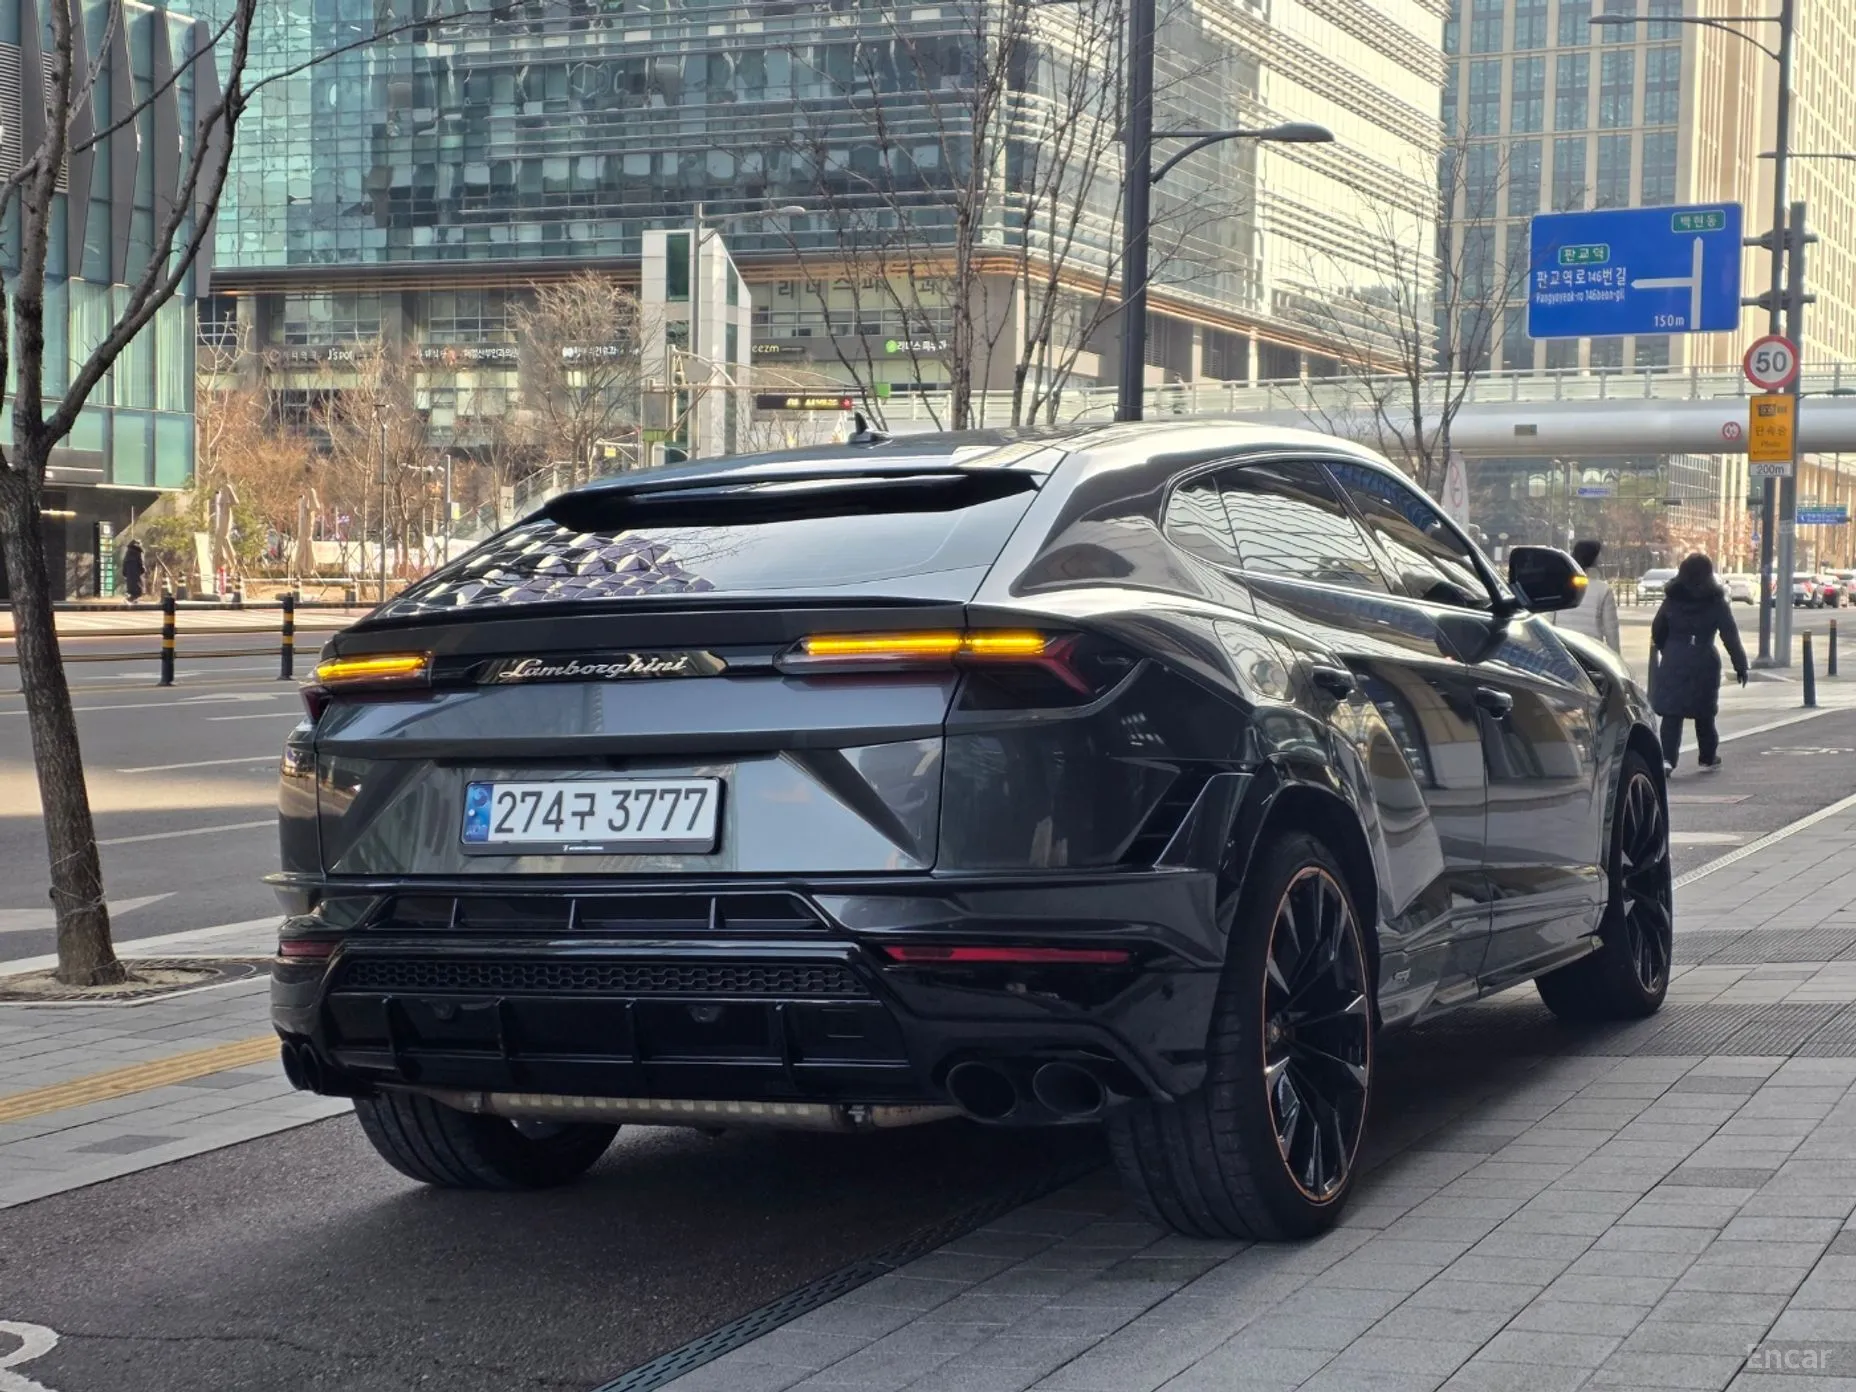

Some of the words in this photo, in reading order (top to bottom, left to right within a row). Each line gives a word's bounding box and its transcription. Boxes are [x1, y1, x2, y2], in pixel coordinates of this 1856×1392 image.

[1563, 246, 1605, 263] 판교역
[1654, 314, 1685, 327] 150m
[1755, 351, 1788, 373] 50
[1755, 464, 1785, 475] 200m
[499, 656, 689, 679] Lamborghini
[494, 789, 597, 834] 274구
[607, 787, 708, 833] 3777
